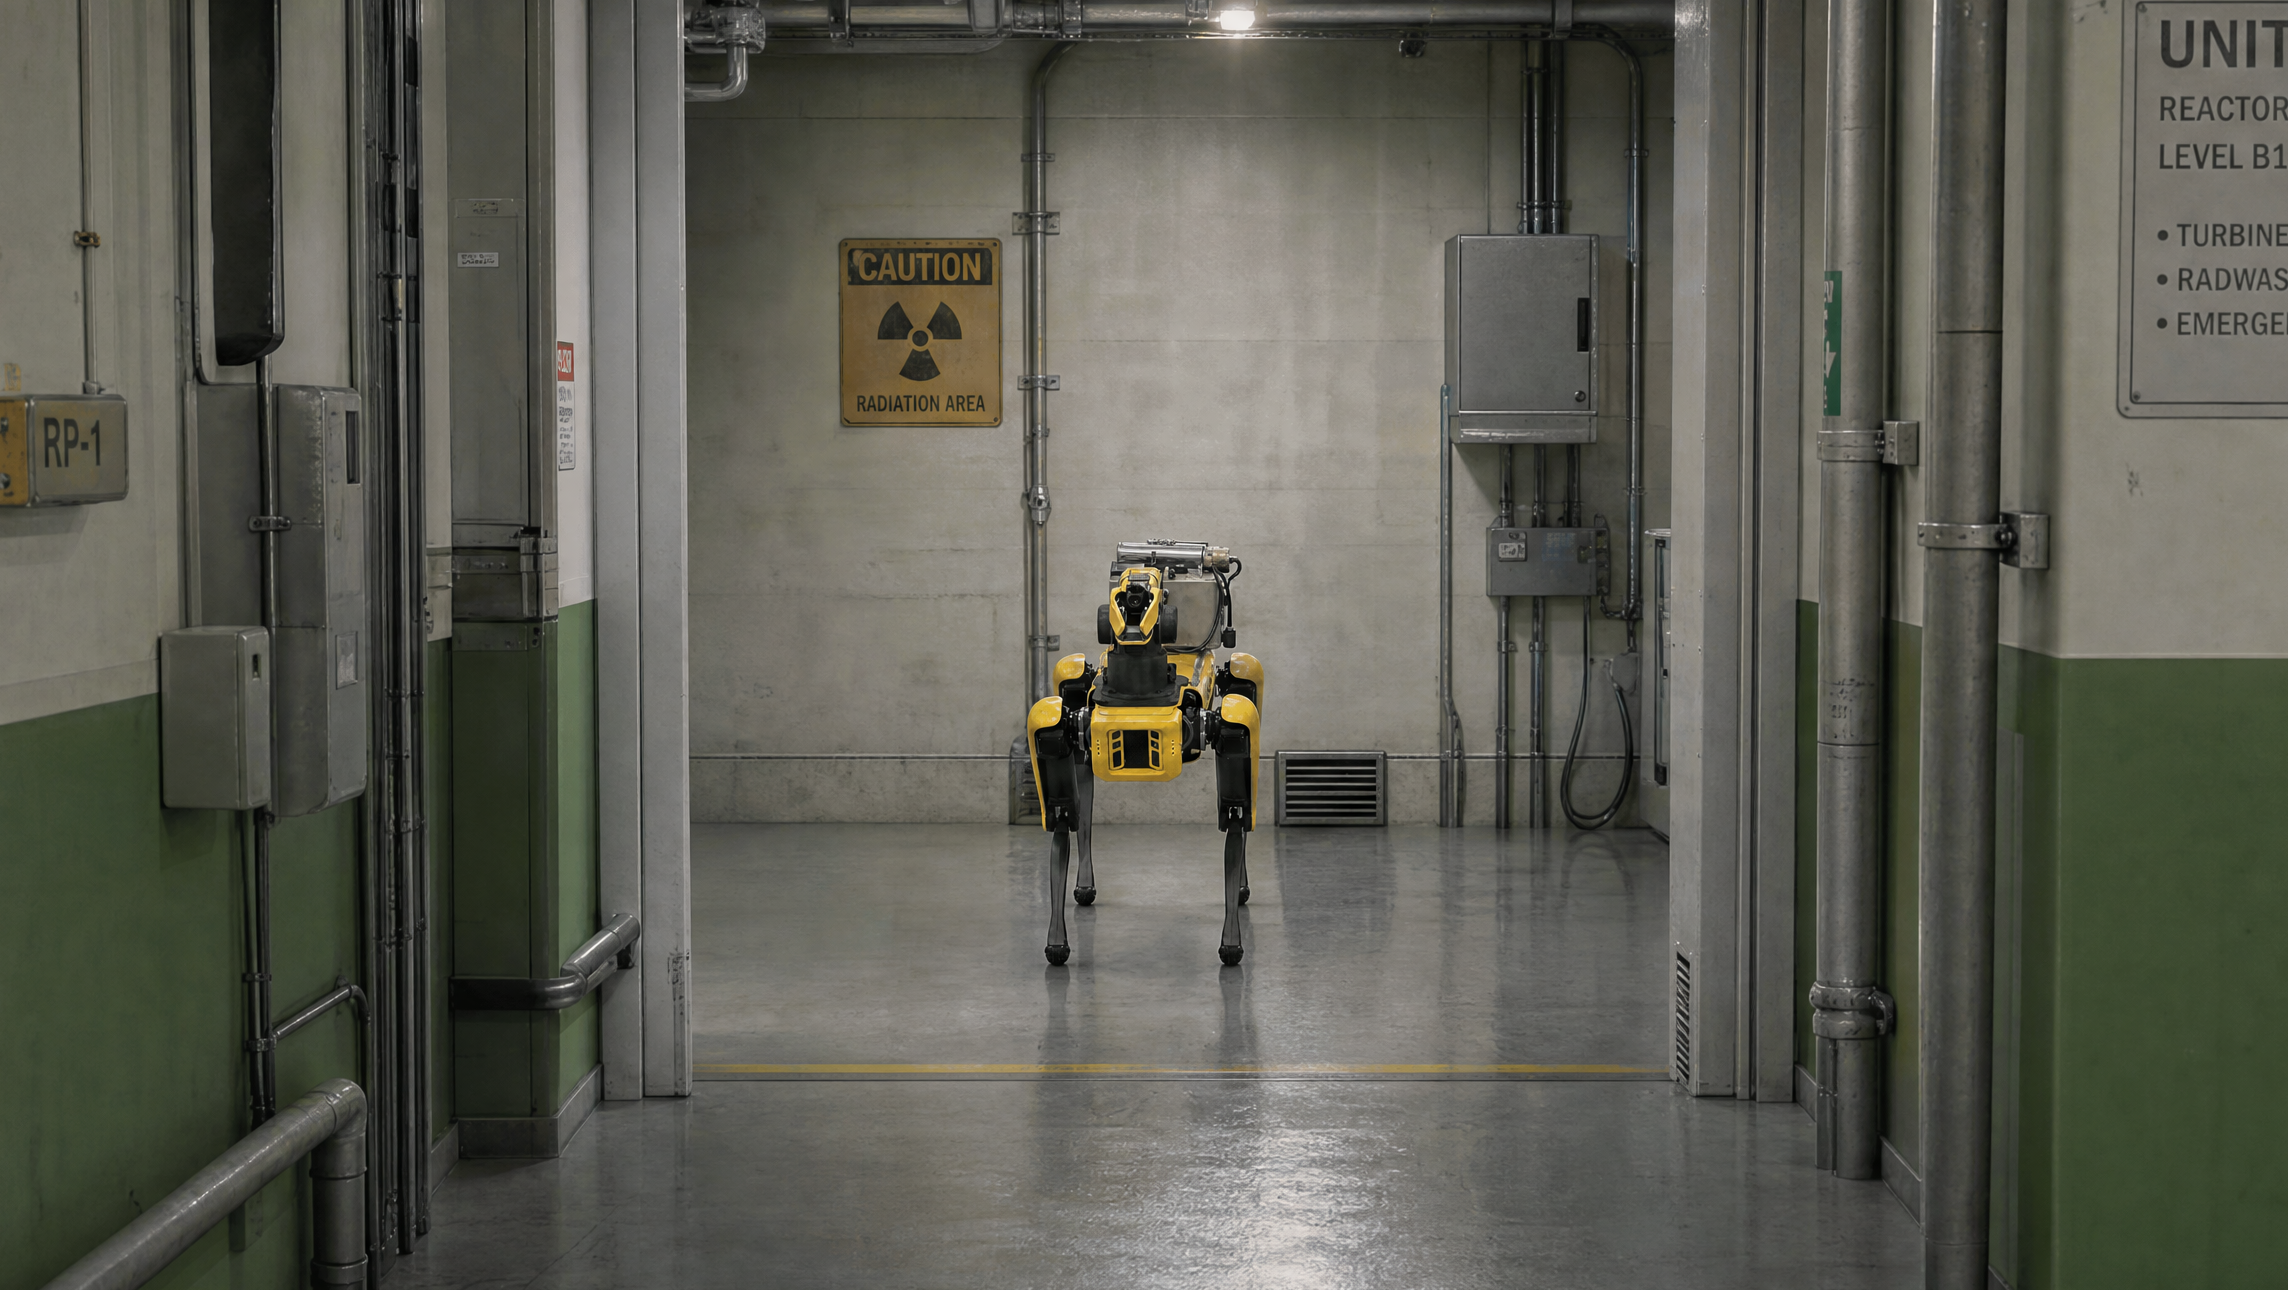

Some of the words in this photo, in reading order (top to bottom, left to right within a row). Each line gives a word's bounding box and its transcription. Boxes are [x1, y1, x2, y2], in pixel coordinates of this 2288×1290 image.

[2161, 20, 2288, 68] UNIT
[2160, 95, 2288, 121] REACTOR
[2159, 143, 2243, 169] LEVEL
[2252, 143, 2287, 169] B1
[2176, 223, 2288, 247] TURBINE
[859, 252, 981, 281] CAUTION
[2178, 267, 2288, 291] RADWAS
[2177, 311, 2288, 335] EMERGE
[857, 395, 940, 412] RADIATION
[945, 395, 986, 412] AREA
[44, 417, 101, 468] RP-1
